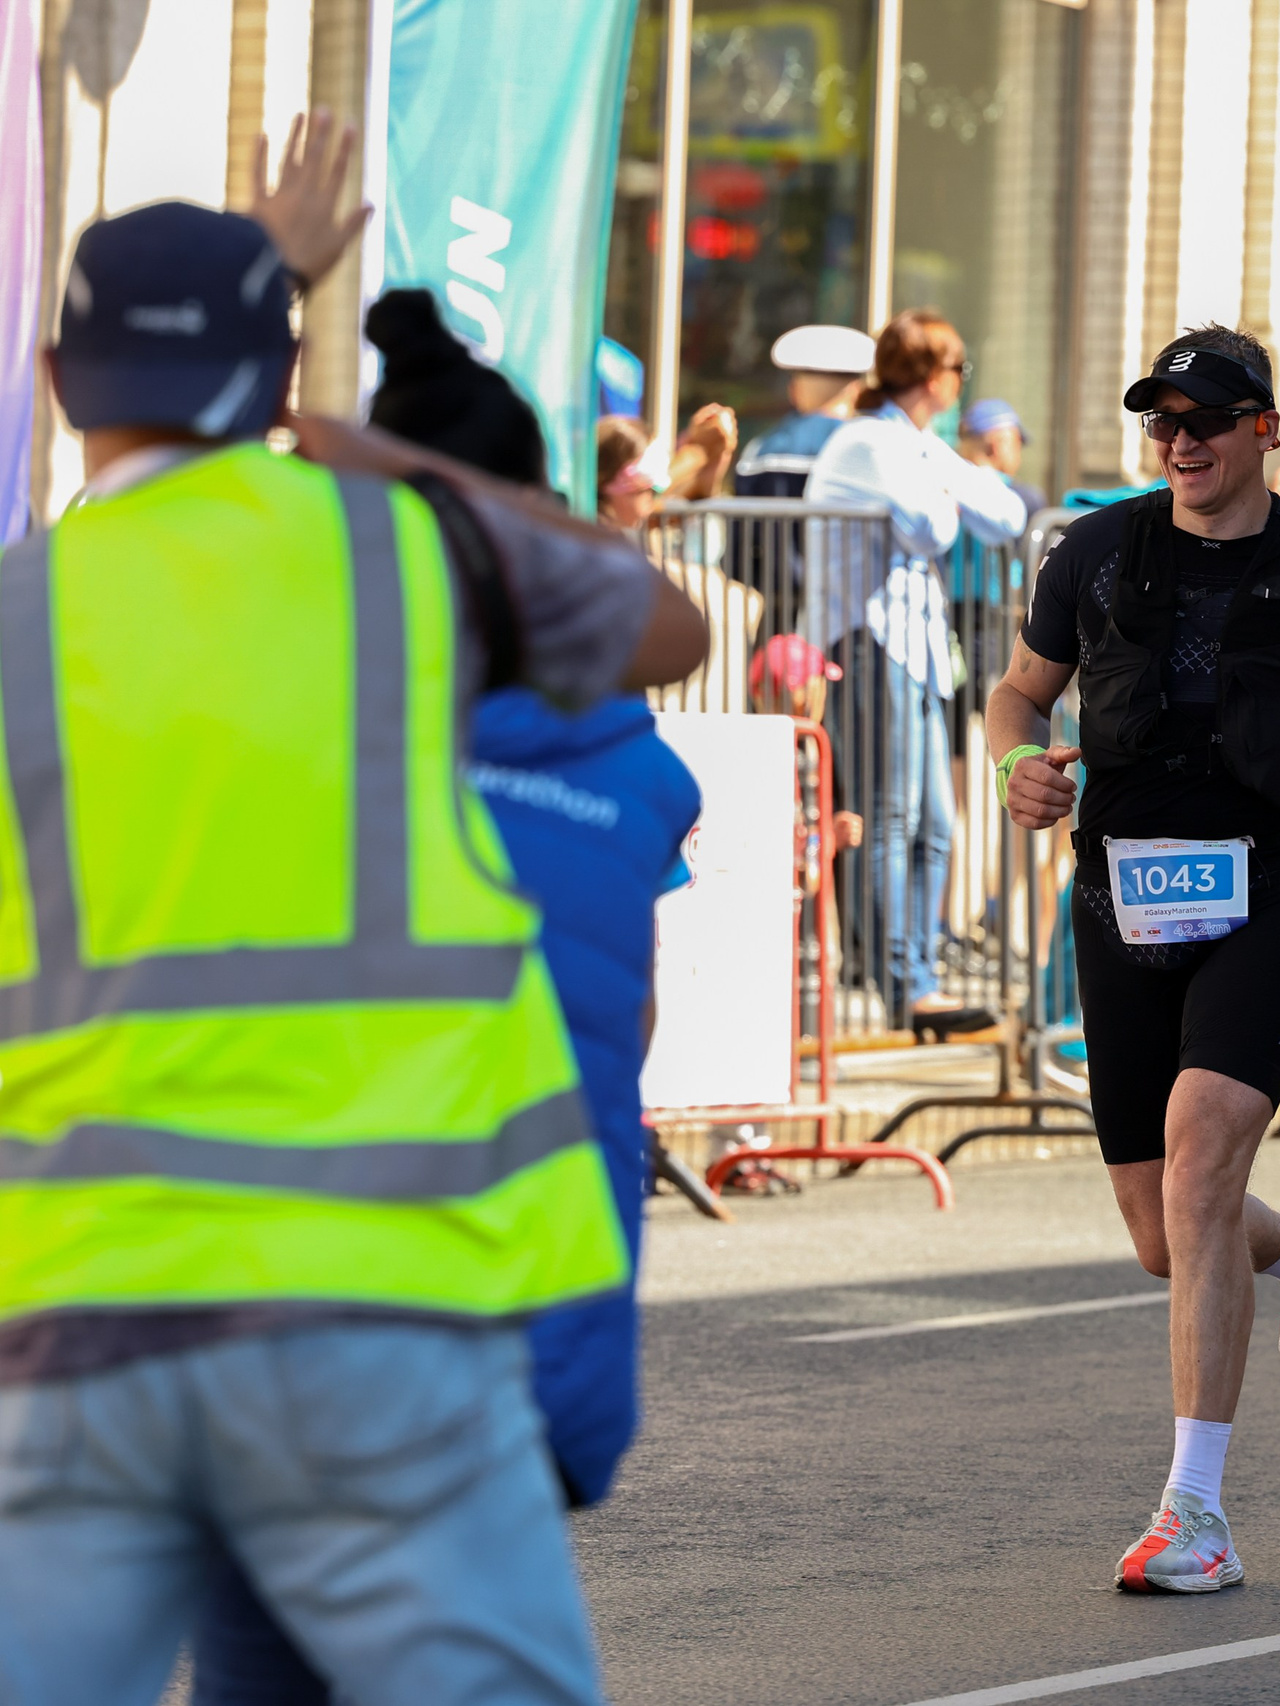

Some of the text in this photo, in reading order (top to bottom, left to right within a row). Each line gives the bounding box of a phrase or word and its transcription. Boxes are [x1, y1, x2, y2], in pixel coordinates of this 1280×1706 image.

[460, 762, 621, 831] arathon
[1131, 864, 1216, 896] 1043
[1144, 906, 1208, 917] #GalaxyMarathon
